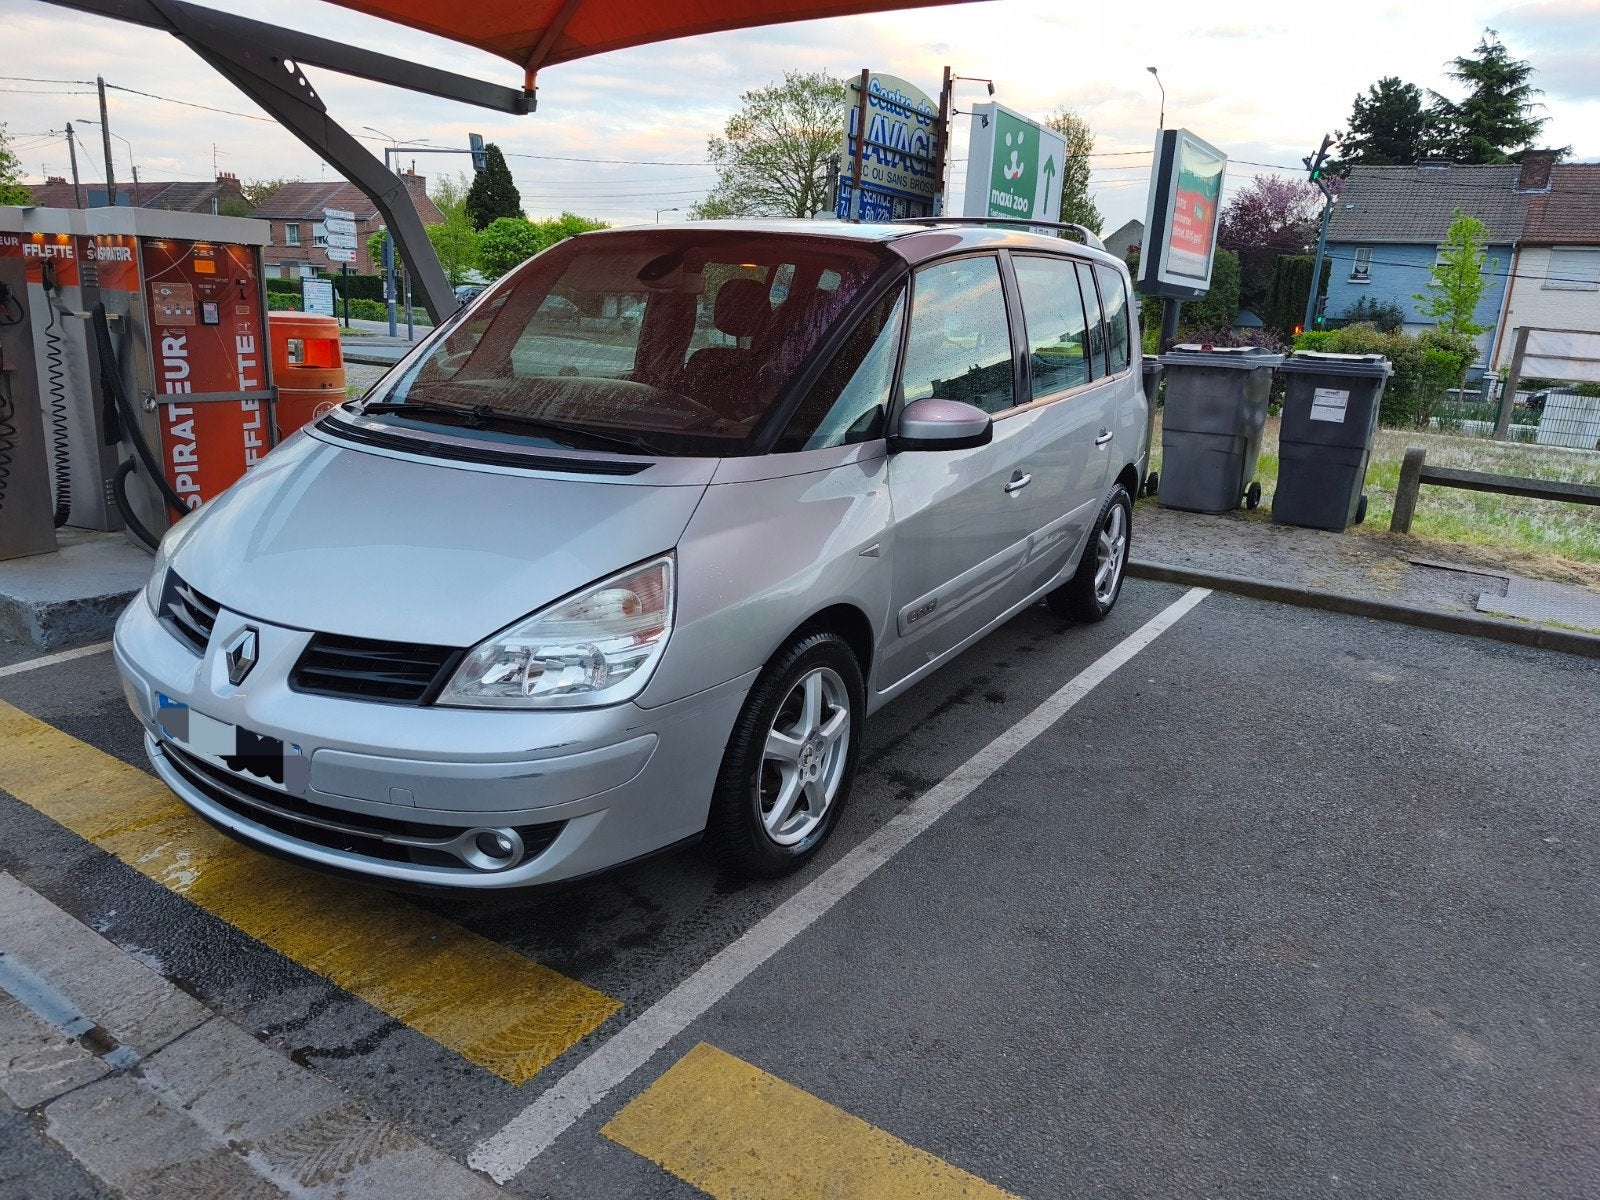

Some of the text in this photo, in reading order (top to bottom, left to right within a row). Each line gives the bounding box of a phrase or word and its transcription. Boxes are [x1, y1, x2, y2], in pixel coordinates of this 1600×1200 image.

[868, 77, 932, 126] Centre de
[848, 105, 938, 178] LAVAGE
[871, 167, 884, 181] OU
[886, 171, 908, 187] SANS
[991, 187, 1029, 213] maxi zoo
